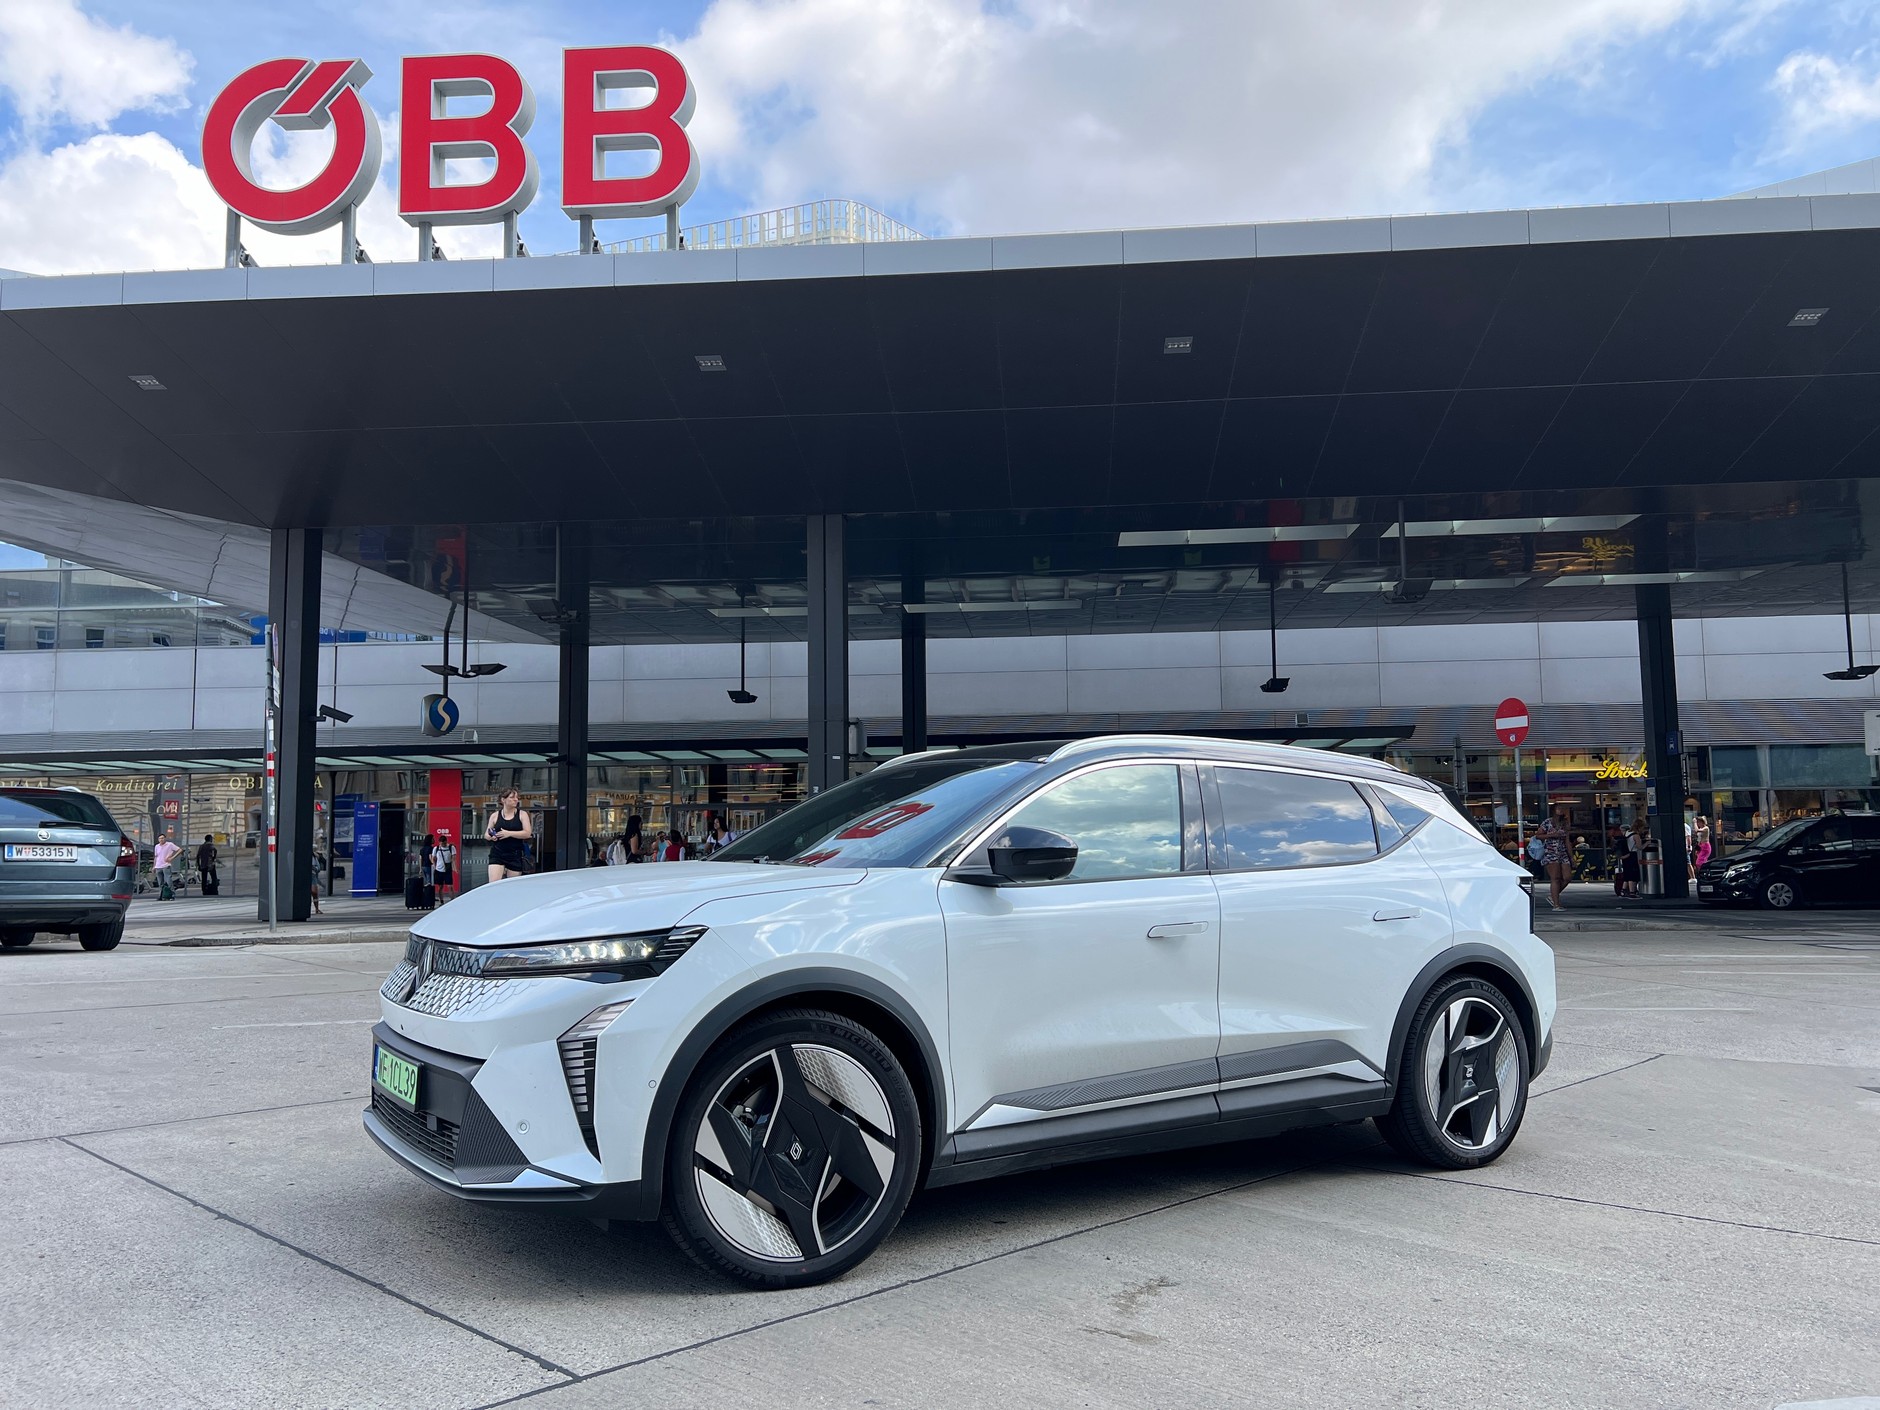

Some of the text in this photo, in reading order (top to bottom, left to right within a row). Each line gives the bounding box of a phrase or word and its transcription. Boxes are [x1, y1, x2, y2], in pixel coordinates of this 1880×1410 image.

[200, 44, 697, 233] ÖBB
[1596, 760, 1648, 779] Ströck
[96, 779, 178, 792] Konditorei
[15, 847, 73, 857] W 53315 N
[834, 1027, 892, 1072] MICHELIN
[390, 1059, 416, 1099] 1CL39
